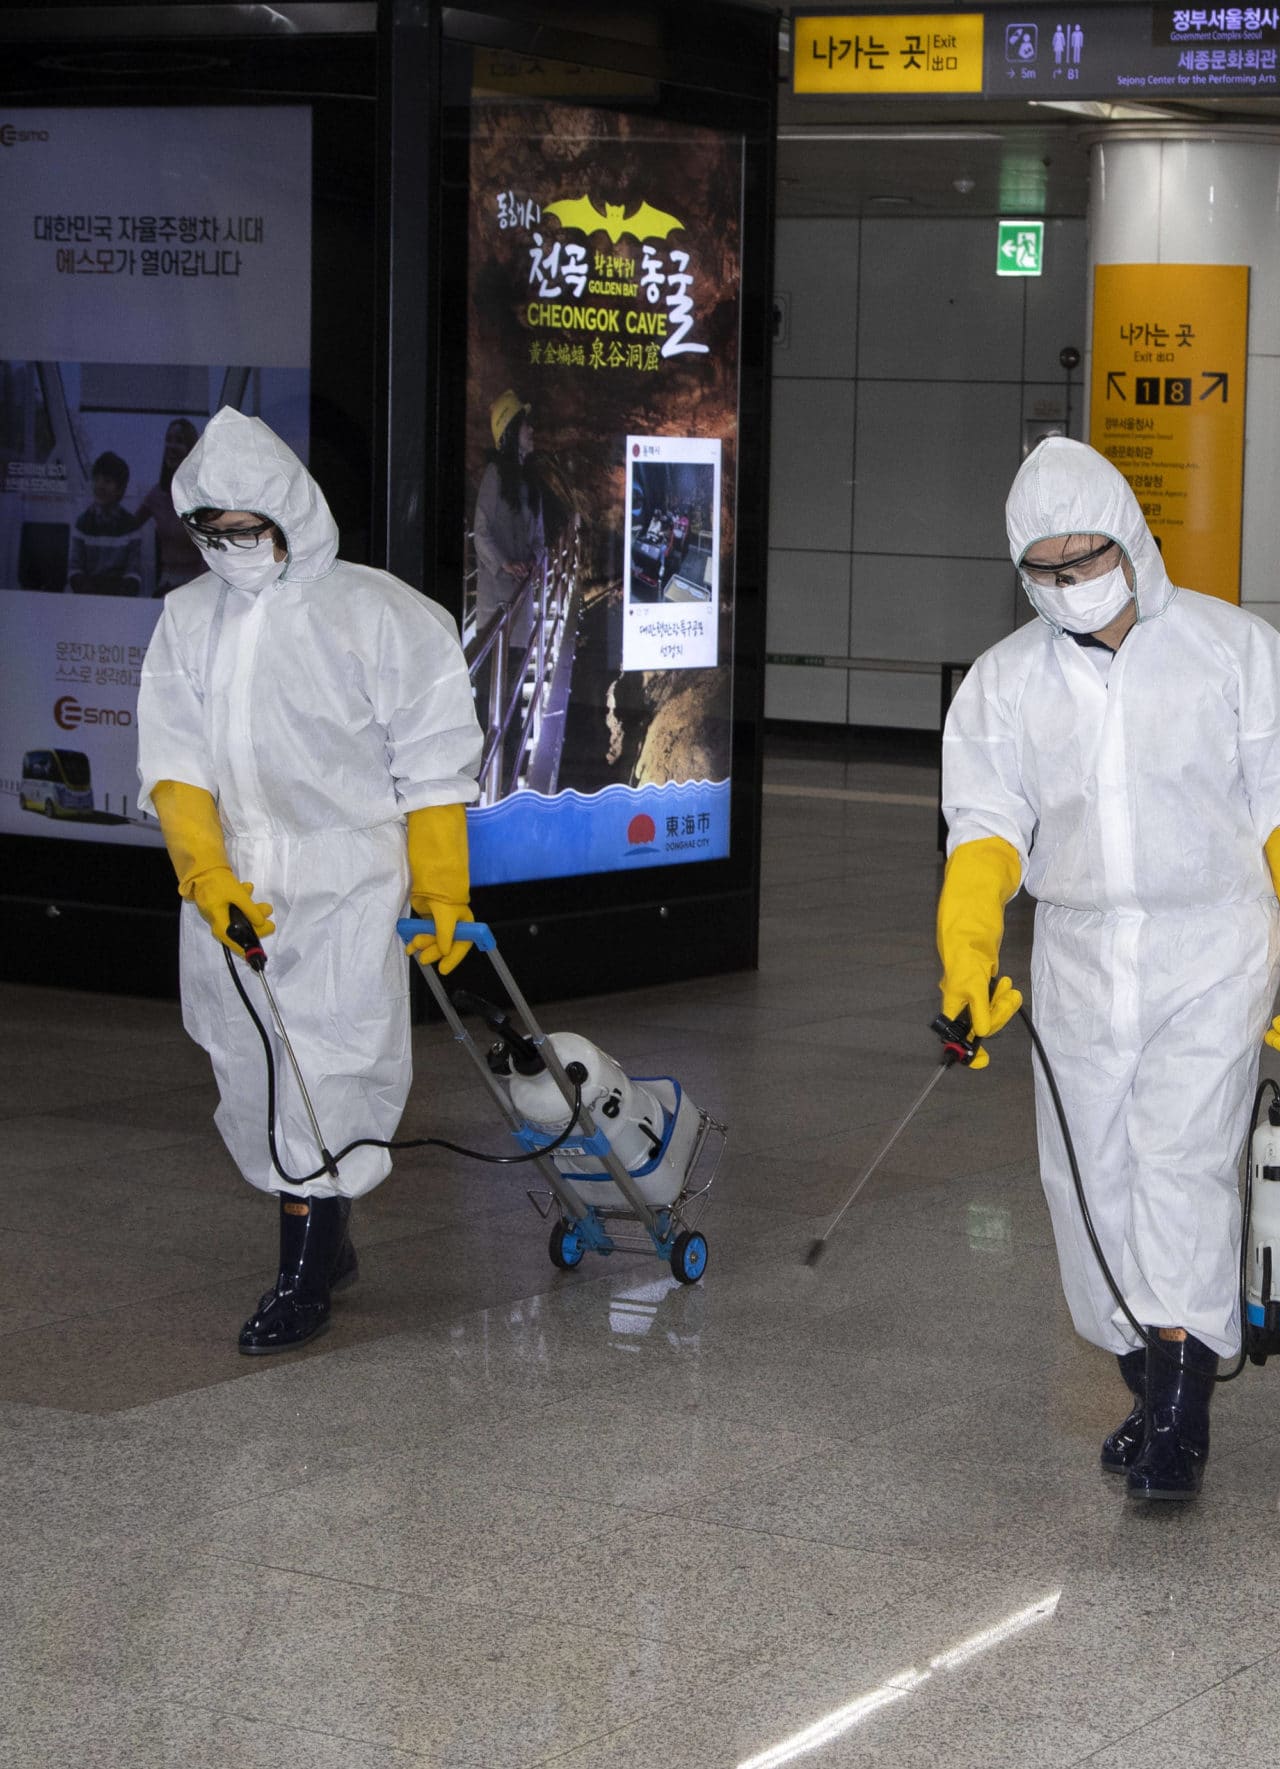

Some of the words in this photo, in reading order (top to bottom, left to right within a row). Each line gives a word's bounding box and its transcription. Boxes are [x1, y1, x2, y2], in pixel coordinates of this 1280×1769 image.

[1173, 8, 1280, 31] 정부서울청사
[933, 35, 957, 49] Exit
[1170, 32, 1211, 41] Government
[813, 35, 889, 70] 나가는
[900, 36, 926, 69] 곳
[1178, 49, 1277, 70] 세종문화회관
[931, 56, 958, 71] 出口
[1021, 68, 1036, 79] 5m
[1067, 68, 1079, 80] B1
[1117, 76, 1146, 87] Sejong
[1147, 75, 1175, 85] Center
[1178, 74, 1190, 84] for
[1192, 74, 1206, 84] the
[1209, 74, 1256, 85] Performing
[1259, 73, 1277, 83] Arts
[496, 190, 541, 230] 동해시
[35, 215, 113, 242] 대한민국
[118, 215, 220, 243] 자율주행차
[223, 217, 264, 244] 시대
[56, 249, 135, 275] 에스모가
[141, 250, 242, 277] 열어갑니다
[594, 251, 635, 278] 황금박쥐
[529, 232, 589, 298] 천곡
[640, 245, 709, 358] 동굴
[588, 280, 622, 296] GOLDEN
[623, 283, 639, 297] BAT
[527, 303, 620, 332] CHEONGOK
[625, 311, 668, 336] CAVE
[1120, 323, 1170, 347] 나가는
[1175, 324, 1196, 347] 곳
[1134, 351, 1152, 362] Exit
[1156, 351, 1175, 362] 出口
[1143, 382, 1150, 402] 1
[1171, 382, 1185, 403] 8
[56, 641, 96, 662] 운전자
[99, 644, 125, 665] 없이
[56, 665, 92, 684] 스스로
[665, 812, 711, 837] 東海市
[697, 838, 710, 848] CITY
